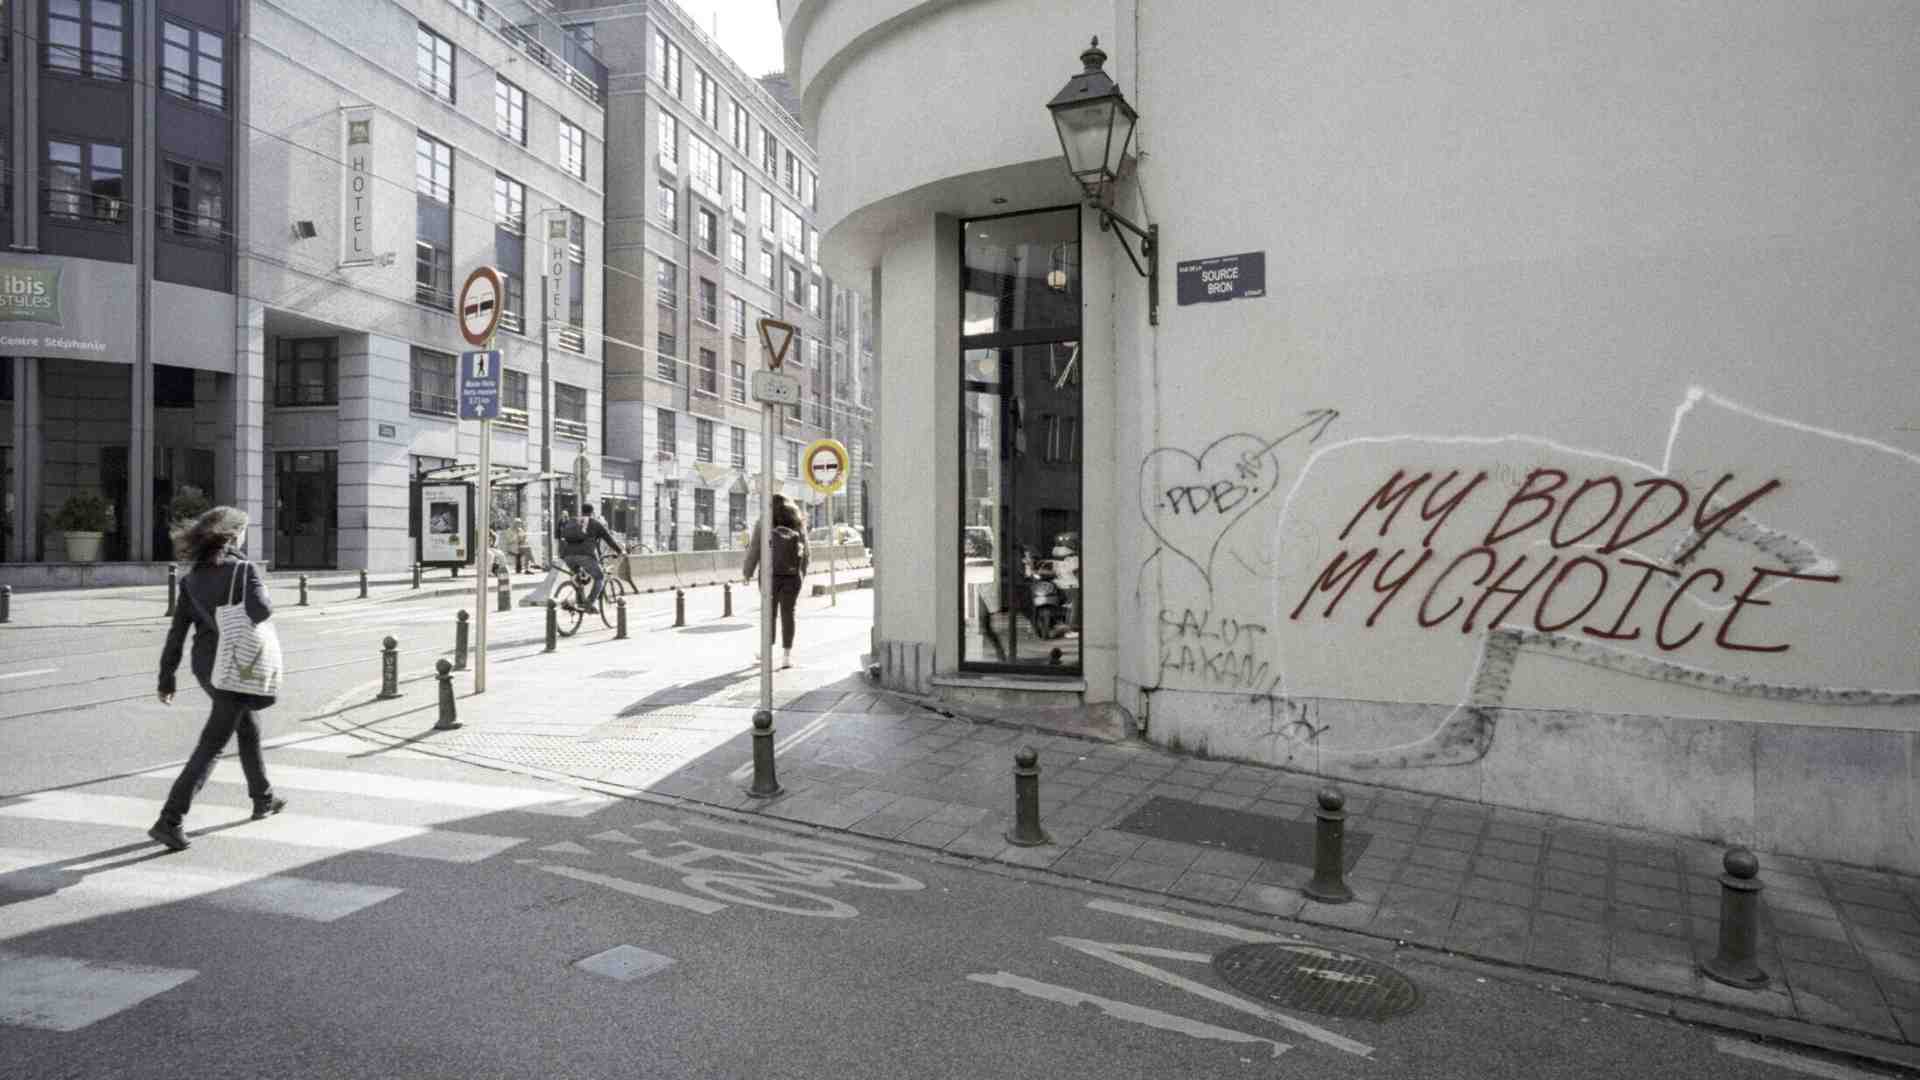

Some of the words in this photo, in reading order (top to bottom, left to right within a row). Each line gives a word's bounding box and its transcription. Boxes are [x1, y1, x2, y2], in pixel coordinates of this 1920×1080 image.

[352, 156, 365, 253] HOTEL
[4, 275, 45, 296] ibis
[552, 247, 563, 321] HOTEL
[1201, 266, 1239, 282] SOURCE
[1207, 281, 1233, 295] BRON
[1339, 468, 1487, 548] MY
[1483, 468, 1782, 565] BODY
[1289, 547, 1433, 628] MY
[1417, 546, 1843, 652] CHOICE
